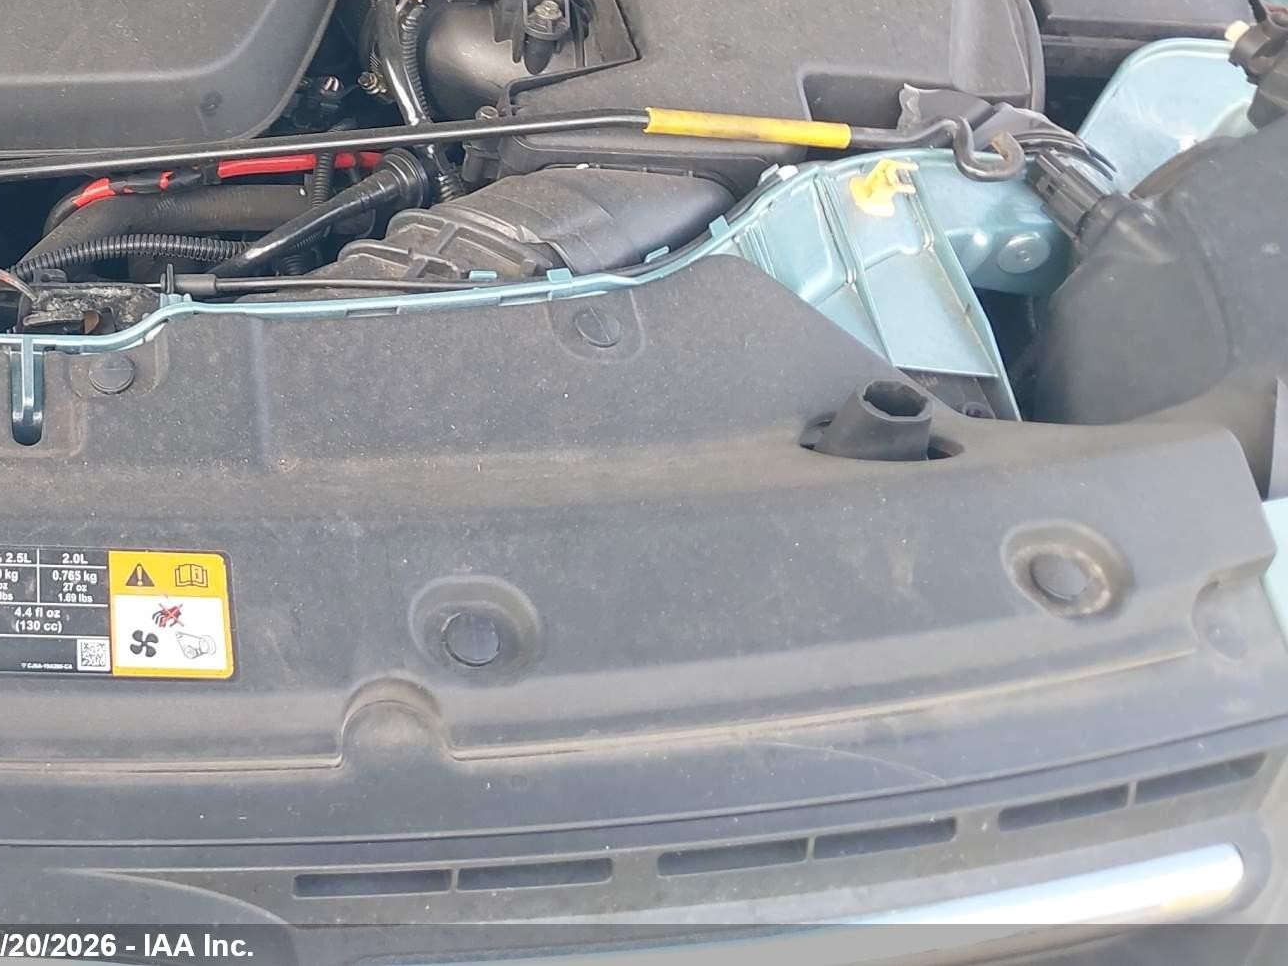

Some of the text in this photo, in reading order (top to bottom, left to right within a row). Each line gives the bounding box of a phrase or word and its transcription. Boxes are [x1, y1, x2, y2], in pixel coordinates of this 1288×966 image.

[5, 552, 32, 564] 2.5L
[62, 553, 88, 565] 2.0L
[5, 569, 19, 583] kg
[52, 569, 98, 585] 0.765 kg
[62, 582, 88, 593] 27 oz
[0, 591, 14, 601] lbs
[78, 593, 94, 603] lbs
[14, 606, 61, 619] 4.4 fl oz
[15, 620, 63, 634] (130 cc)
